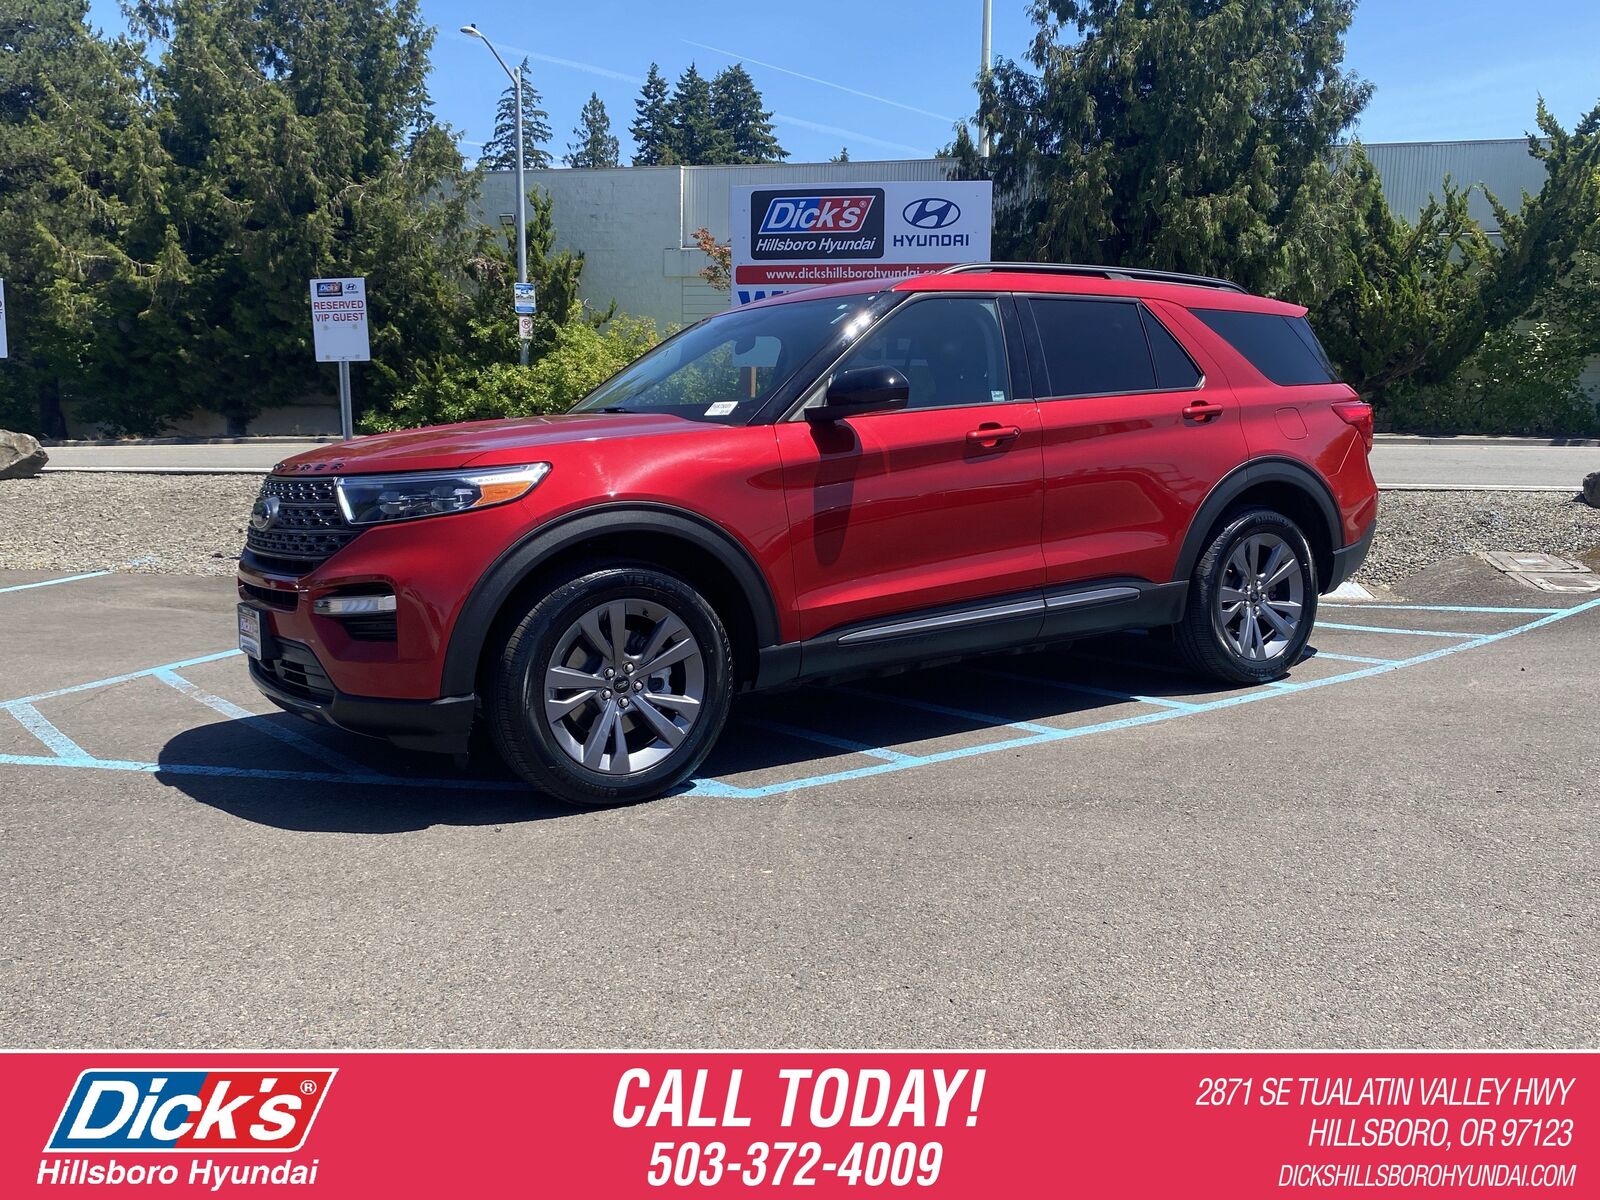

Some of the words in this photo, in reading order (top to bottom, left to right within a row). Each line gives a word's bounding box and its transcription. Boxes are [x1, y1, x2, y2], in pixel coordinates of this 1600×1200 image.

[755, 238, 817, 252] Hillsboro
[818, 236, 877, 254] Hyundai
[893, 234, 970, 247] HYUNDAI
[766, 266, 940, 280] www.dickshillsborohyundai
[313, 300, 364, 310] RESERVED
[315, 313, 330, 322] VIP
[332, 312, 365, 322] GUEST
